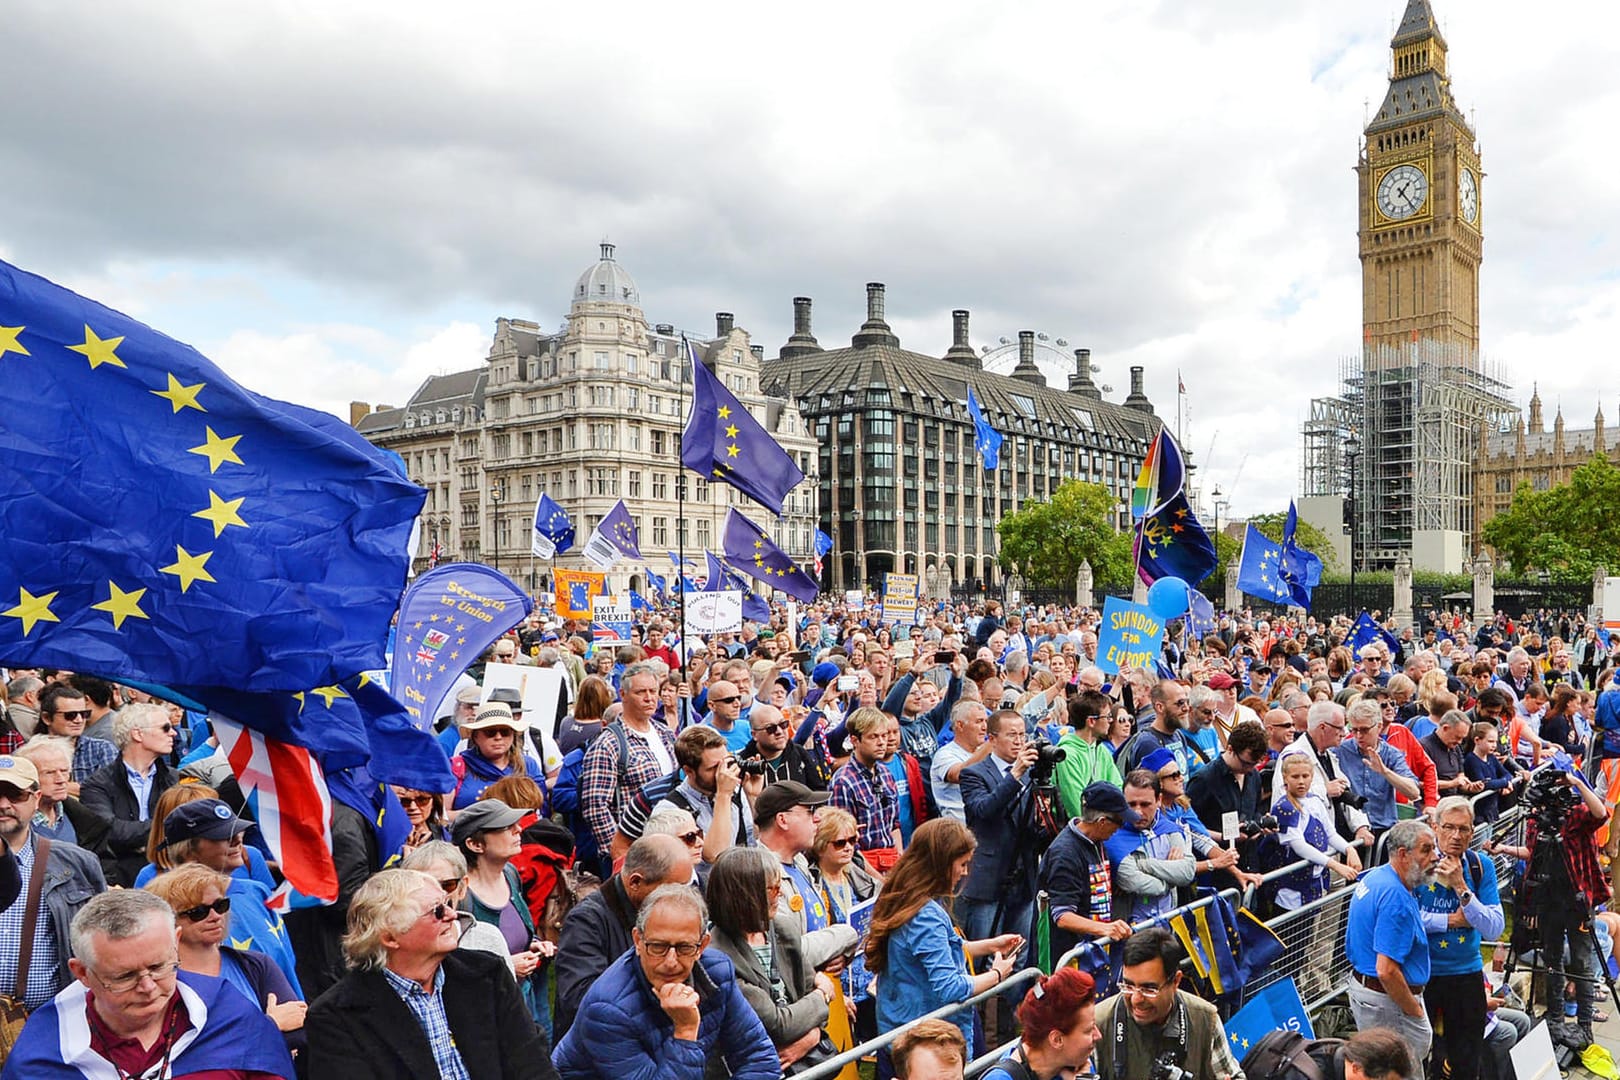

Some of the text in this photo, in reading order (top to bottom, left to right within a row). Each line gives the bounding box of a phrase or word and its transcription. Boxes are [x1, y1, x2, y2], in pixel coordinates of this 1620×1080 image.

[447, 581, 506, 612] Strength
[688, 593, 740, 608] PULLING OUT
[441, 595, 494, 623] in Union
[687, 621, 711, 632] NEVER
[1111, 611, 1159, 638] SWINDON
[1122, 632, 1140, 644] FOR
[1106, 645, 1152, 669] EUROPE
